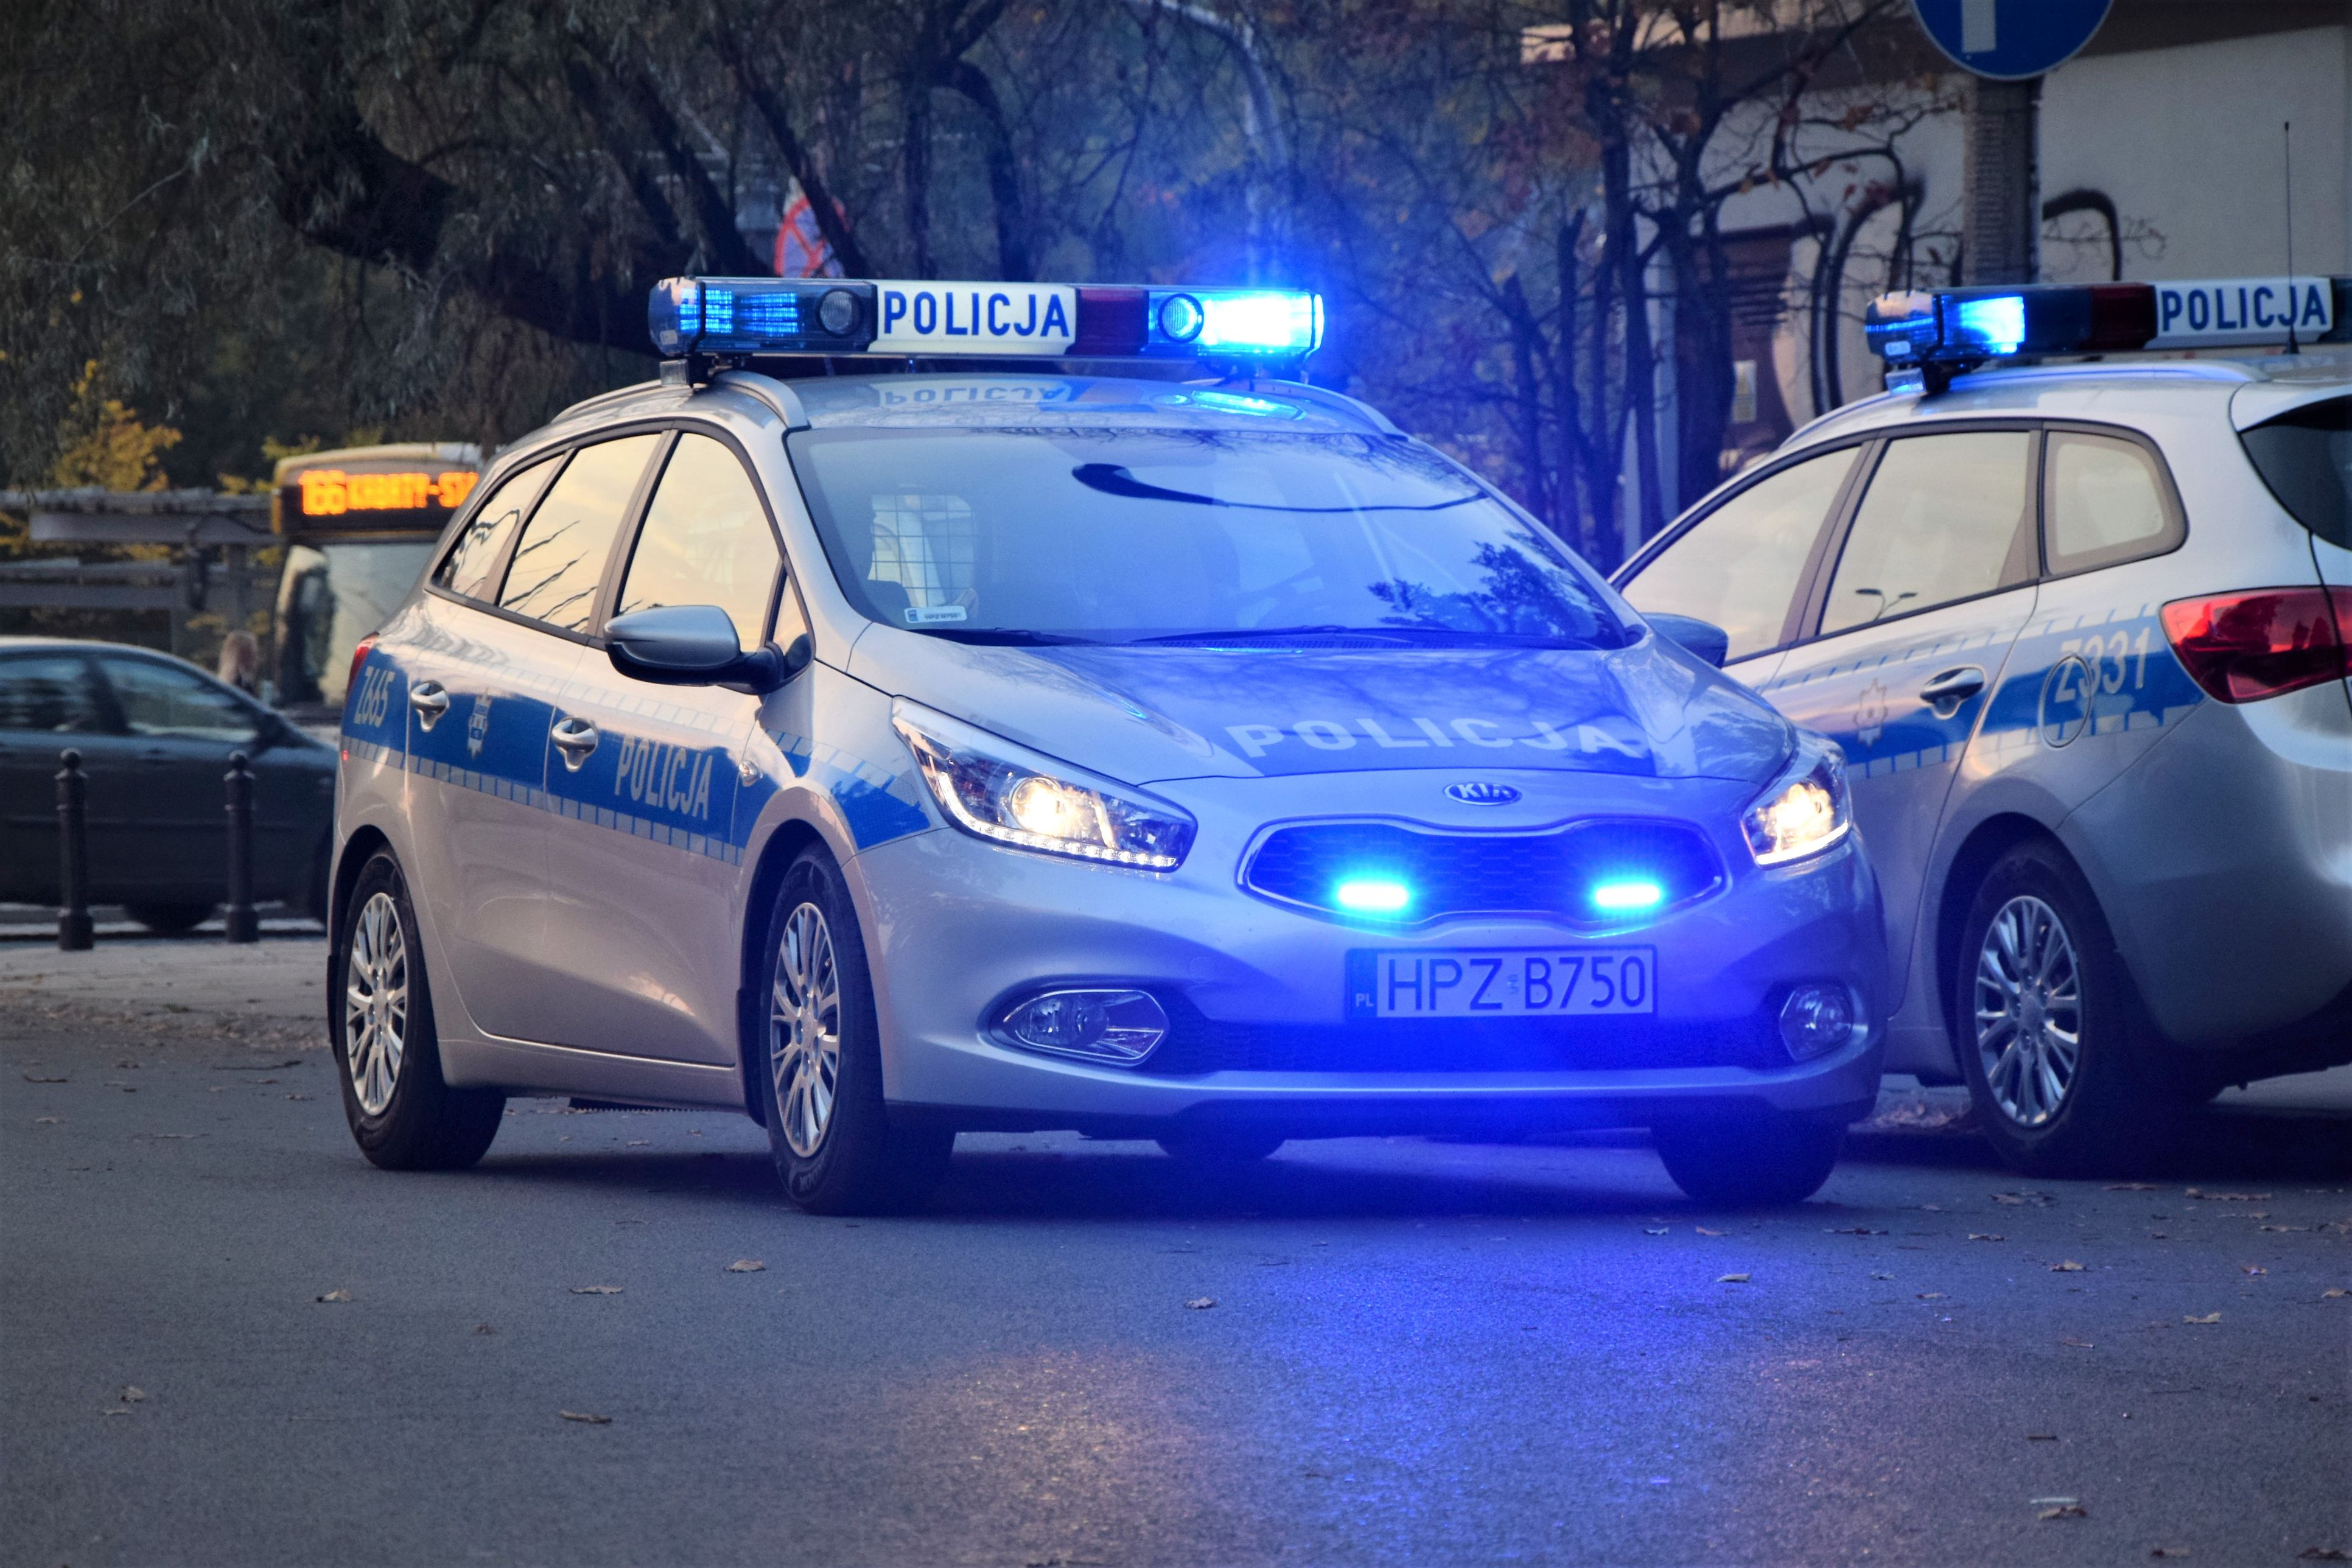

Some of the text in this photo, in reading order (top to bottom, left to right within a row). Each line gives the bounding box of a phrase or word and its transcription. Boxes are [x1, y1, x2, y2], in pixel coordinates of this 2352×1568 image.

[884, 291, 1069, 337] POLICJA
[2162, 285, 2327, 331] POLICJA
[2054, 626, 2151, 704] Z331
[353, 667, 395, 729] Z665
[1224, 717, 1643, 758] POLICJA
[614, 736, 713, 821] POLICJA
[1455, 782, 1515, 799] KIA
[1356, 993, 1374, 1007] PL
[1388, 955, 1645, 1011] HPZ B750
